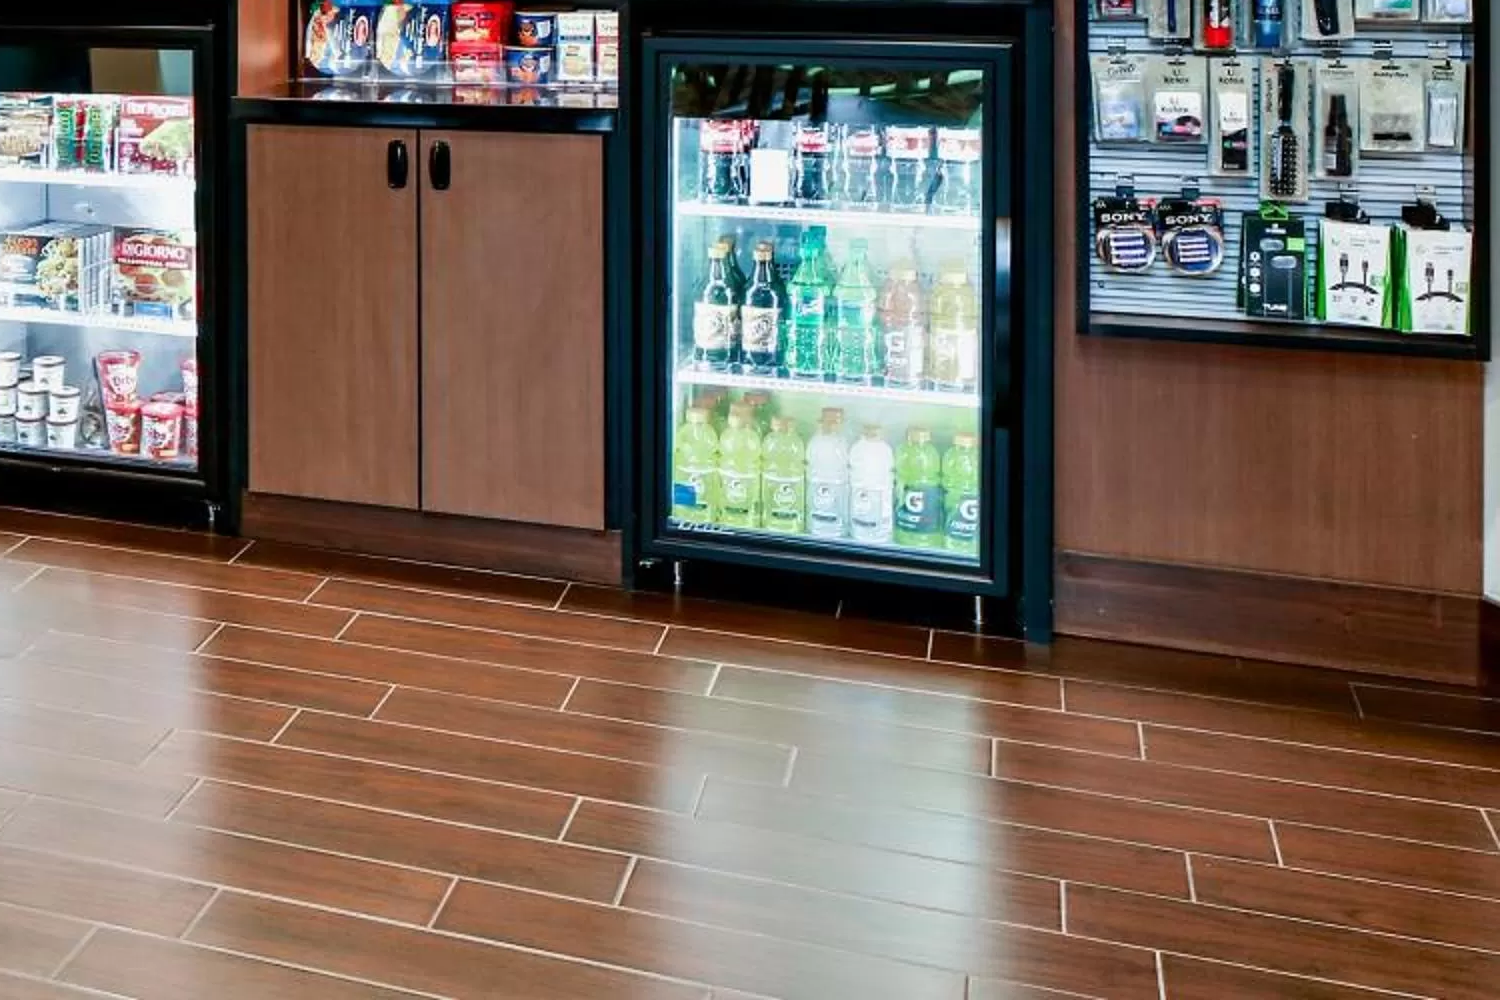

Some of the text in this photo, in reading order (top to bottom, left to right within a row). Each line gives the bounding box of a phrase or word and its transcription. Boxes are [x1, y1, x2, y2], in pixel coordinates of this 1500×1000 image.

[1100, 212, 1147, 223] SONY
[1165, 213, 1213, 225] SONY
[905, 491, 925, 513] G
[959, 499, 979, 521] G
